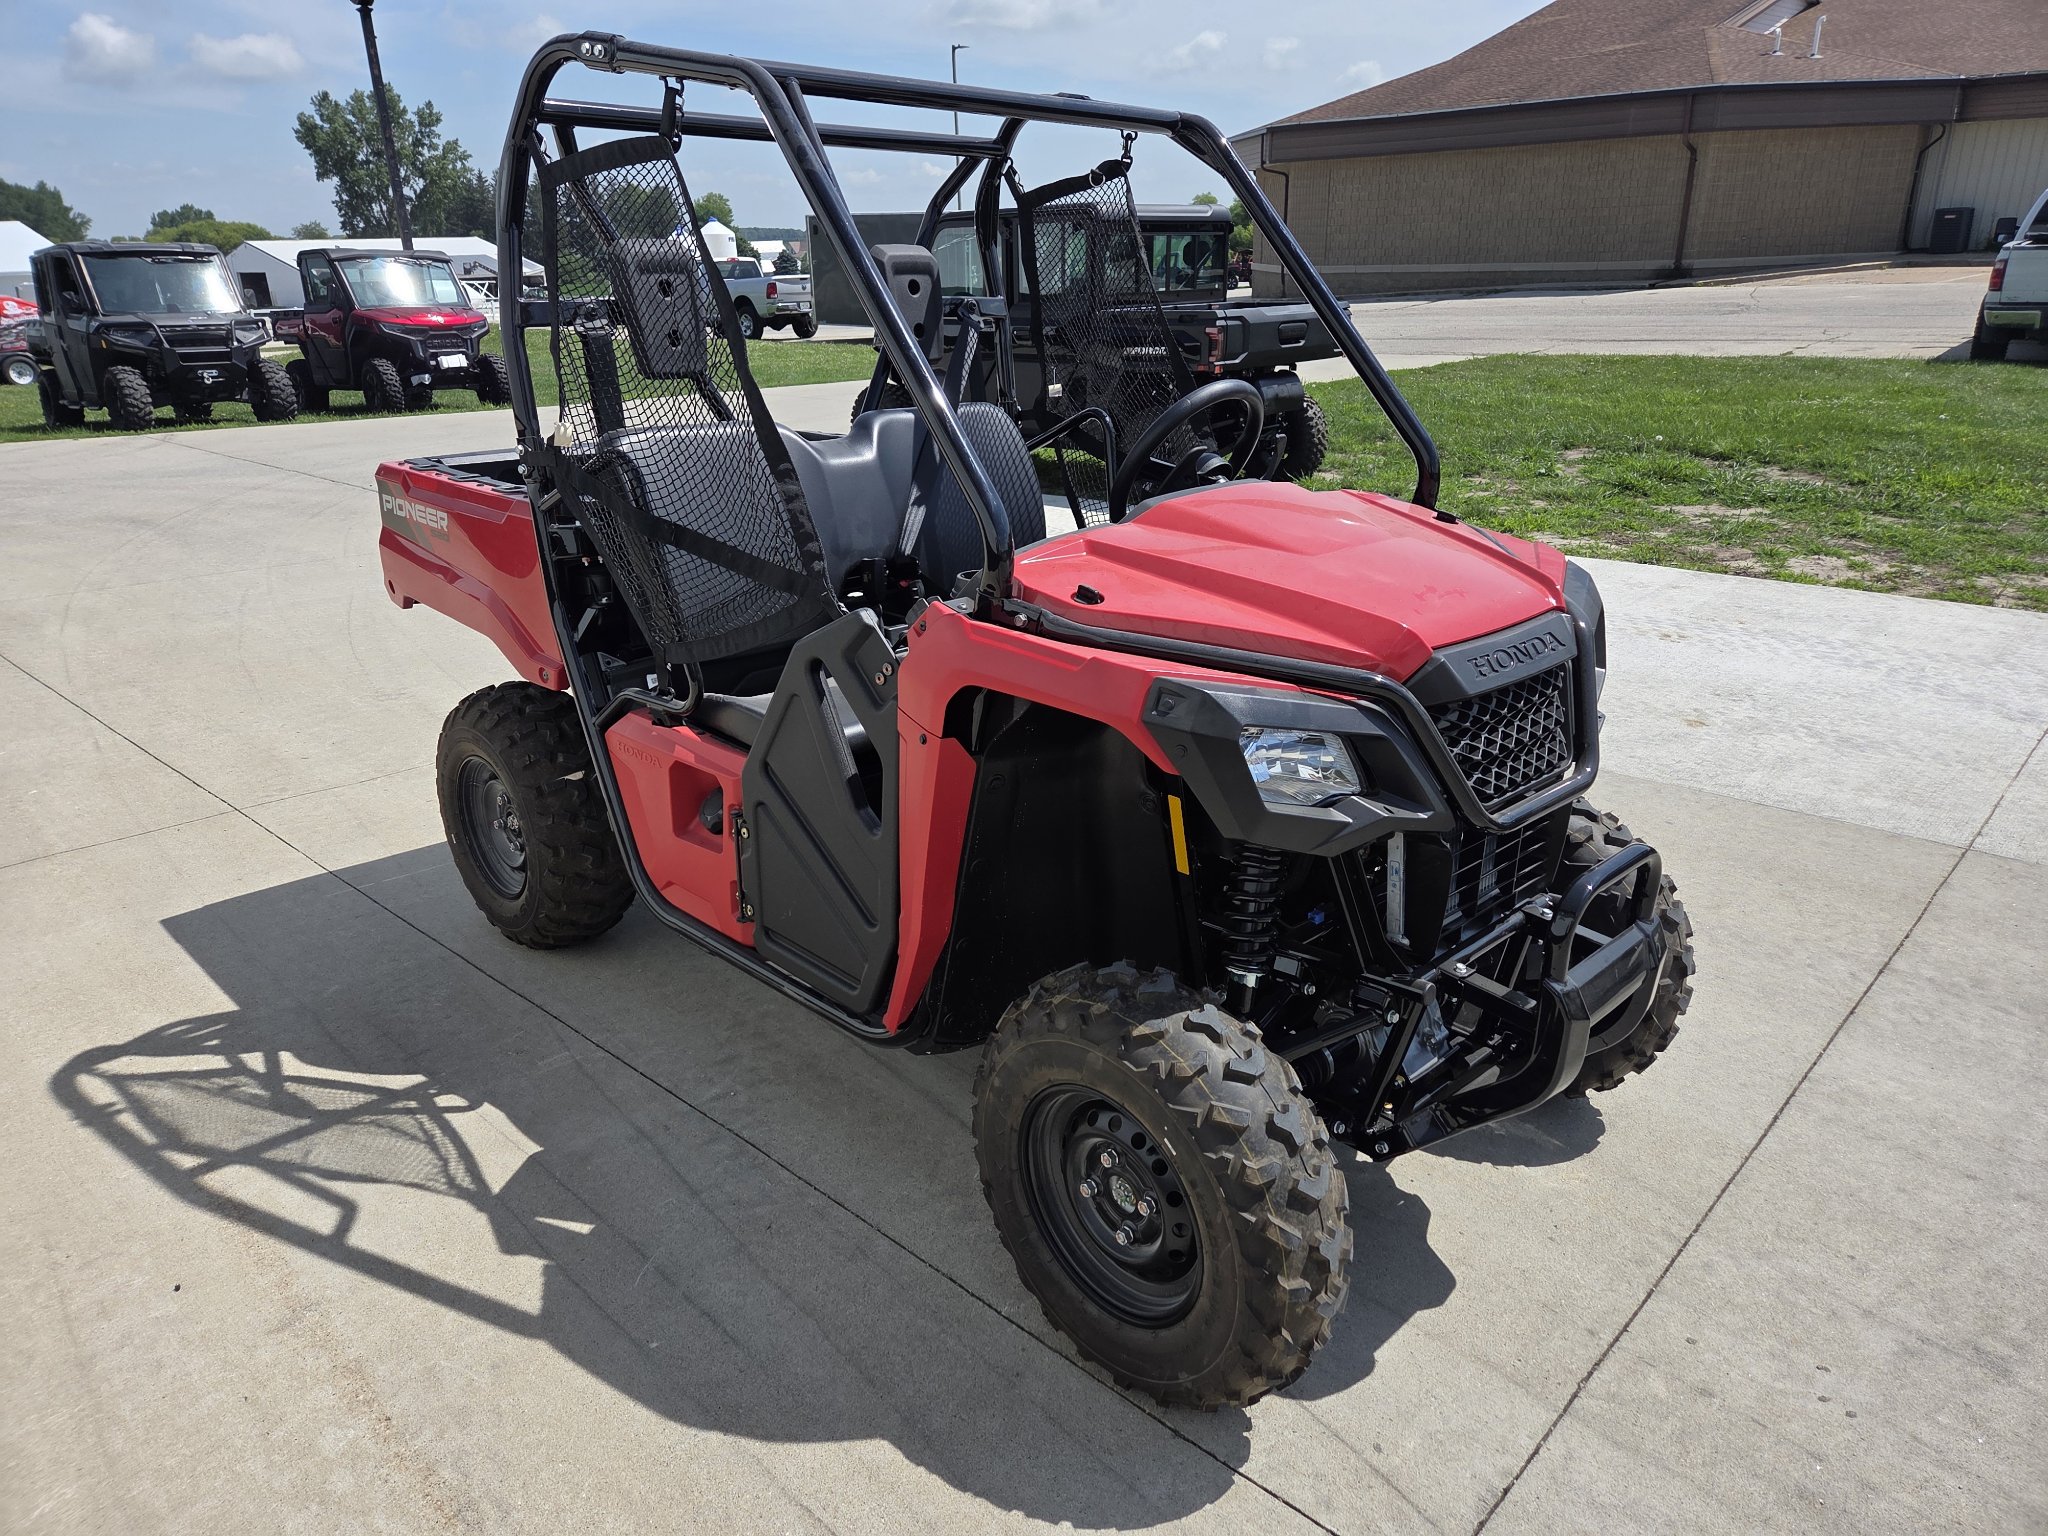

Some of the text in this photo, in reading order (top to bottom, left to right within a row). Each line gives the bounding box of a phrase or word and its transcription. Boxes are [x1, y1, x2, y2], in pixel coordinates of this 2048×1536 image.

[382, 493, 448, 532] PIONEER
[1467, 631, 1566, 679] HONDA
[616, 740, 662, 769] HONDA
